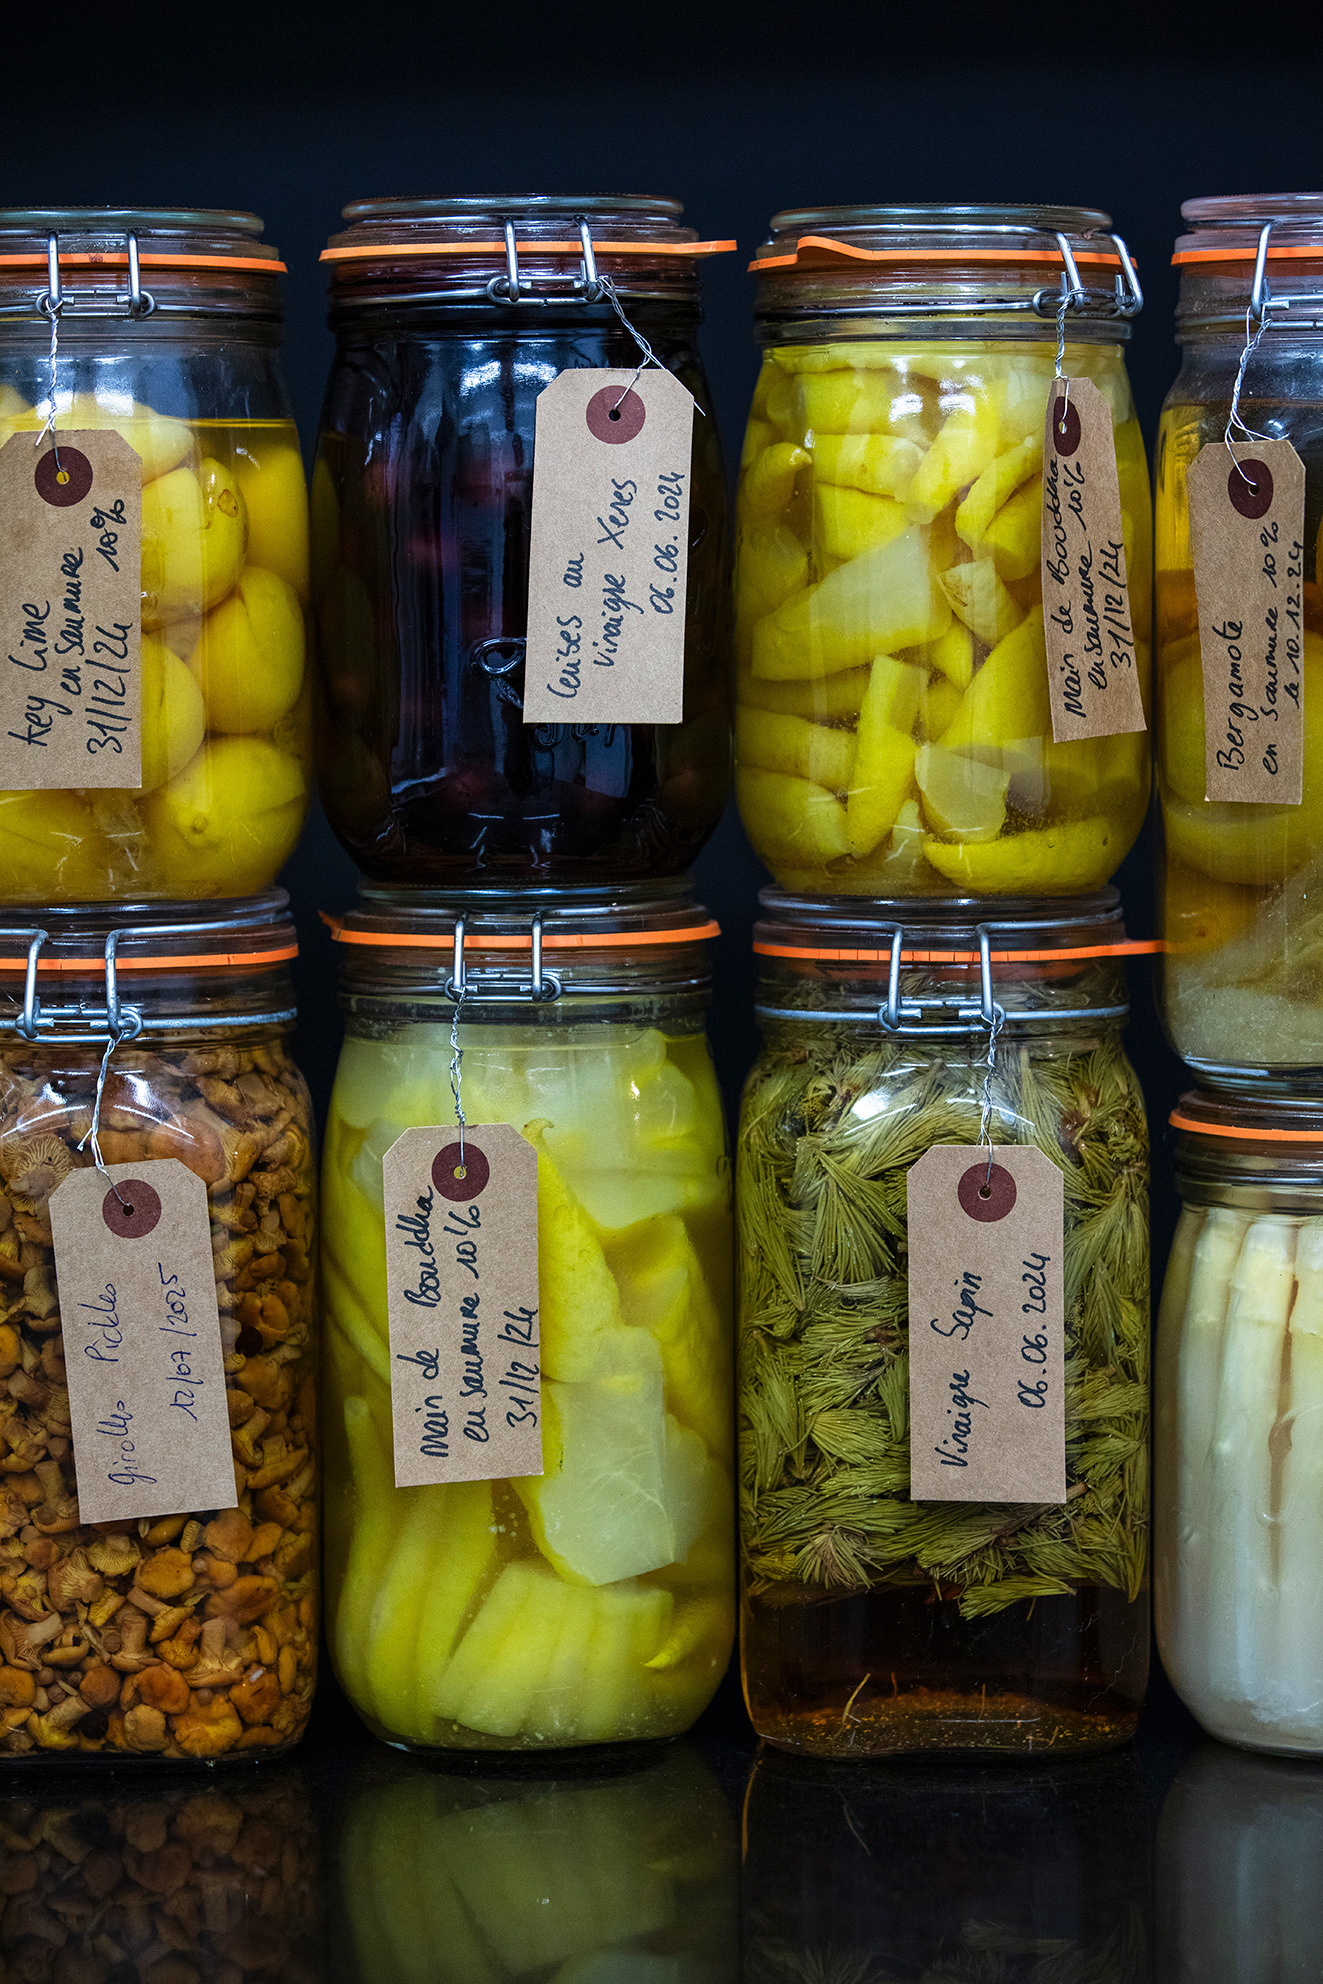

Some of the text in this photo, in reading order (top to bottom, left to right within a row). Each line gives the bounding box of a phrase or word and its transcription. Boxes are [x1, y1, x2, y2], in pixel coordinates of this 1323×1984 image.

[596, 478, 637, 549] Xeres
[562, 552, 584, 589] au
[1046, 454, 1086, 718] Main de Bouddha
[1259, 521, 1278, 587] 10%
[58, 666, 82, 695] en
[90, 498, 126, 572] 10%
[1284, 540, 1303, 709] le 10.12.24
[8, 600, 49, 671] Lime
[1087, 656, 1107, 690] en
[85, 622, 132, 754] 31/12/24
[1212, 620, 1259, 771] Bergamote
[1262, 743, 1278, 775] en
[396, 1184, 441, 1307] Bouddha
[77, 1283, 123, 1362] Pickles
[396, 1348, 439, 1380] de
[929, 1272, 994, 1467] Vinaigre Sapin
[462, 1407, 489, 1442] en
